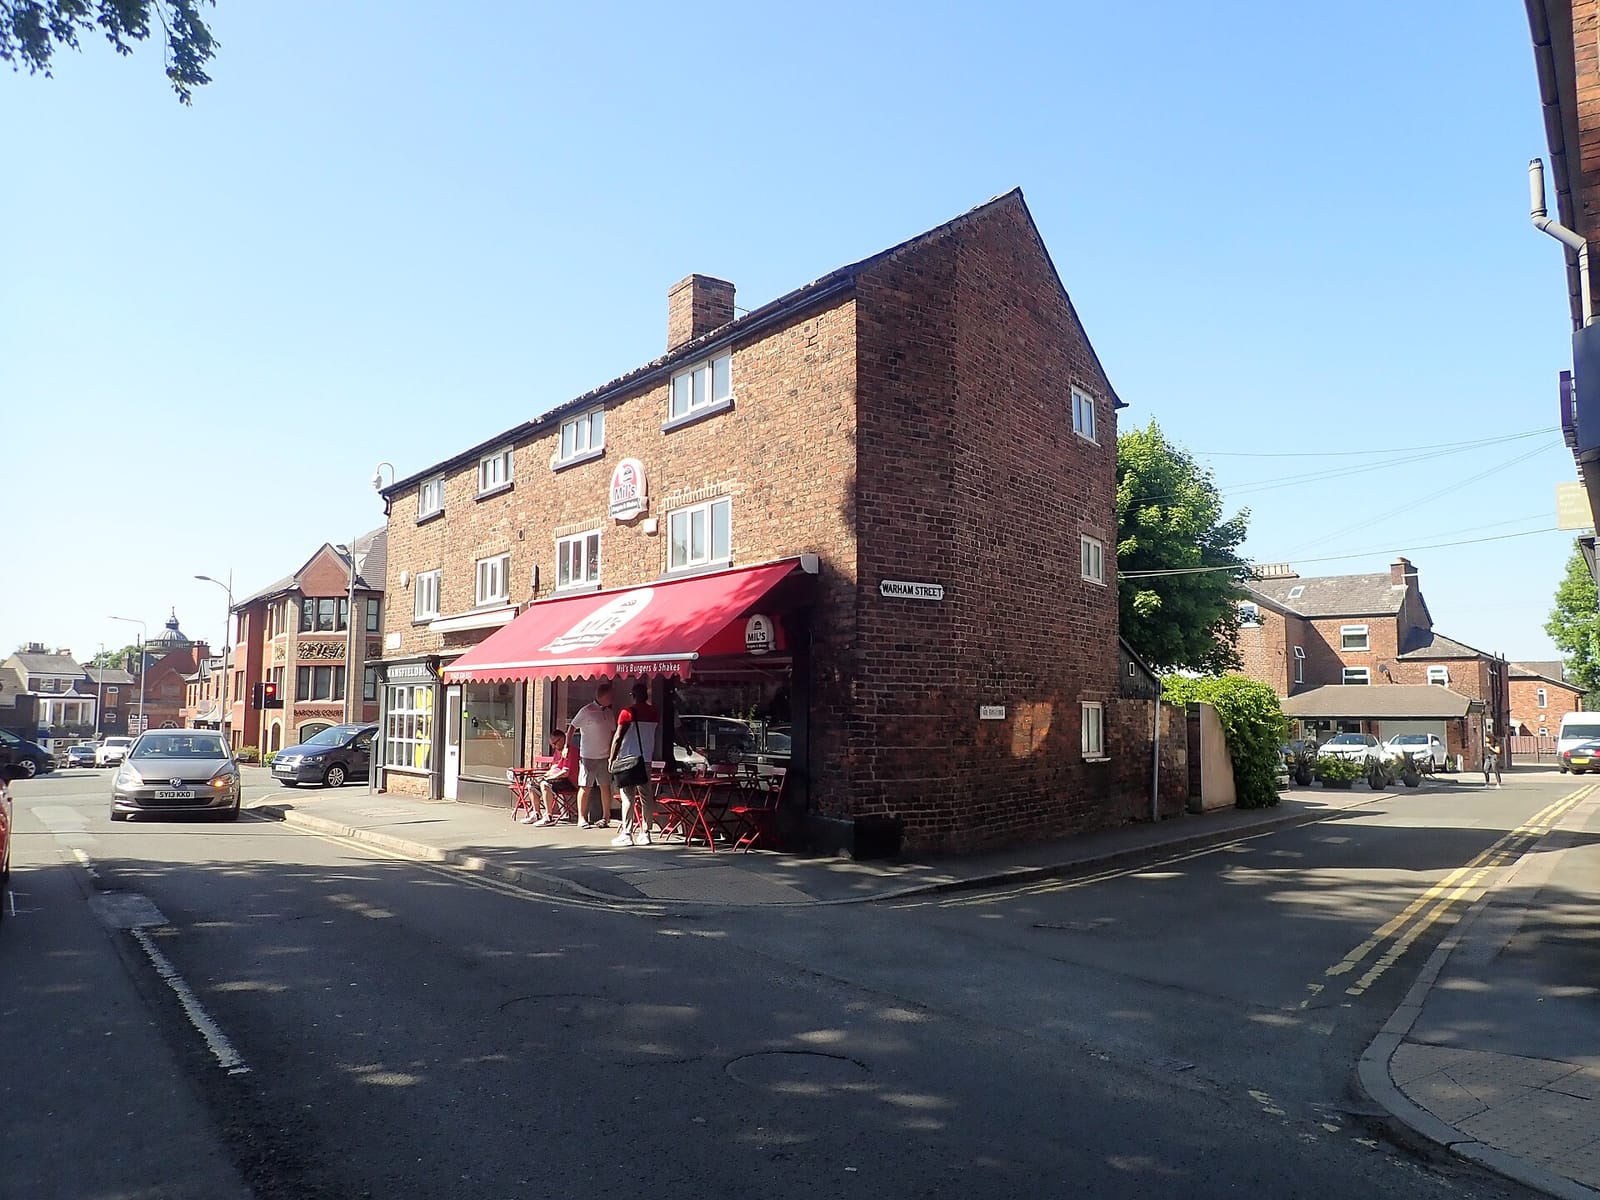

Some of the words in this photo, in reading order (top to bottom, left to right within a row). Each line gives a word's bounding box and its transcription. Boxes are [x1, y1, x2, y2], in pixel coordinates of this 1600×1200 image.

[614, 484, 636, 501] Mil's
[882, 583, 914, 595] WARHAM
[914, 586, 942, 597] STREET
[747, 632, 766, 641] MIL'S
[616, 663, 628, 672] Mil's
[630, 663, 652, 674] Burgers
[652, 663, 657, 672] &
[658, 662, 680, 672] Shakes
